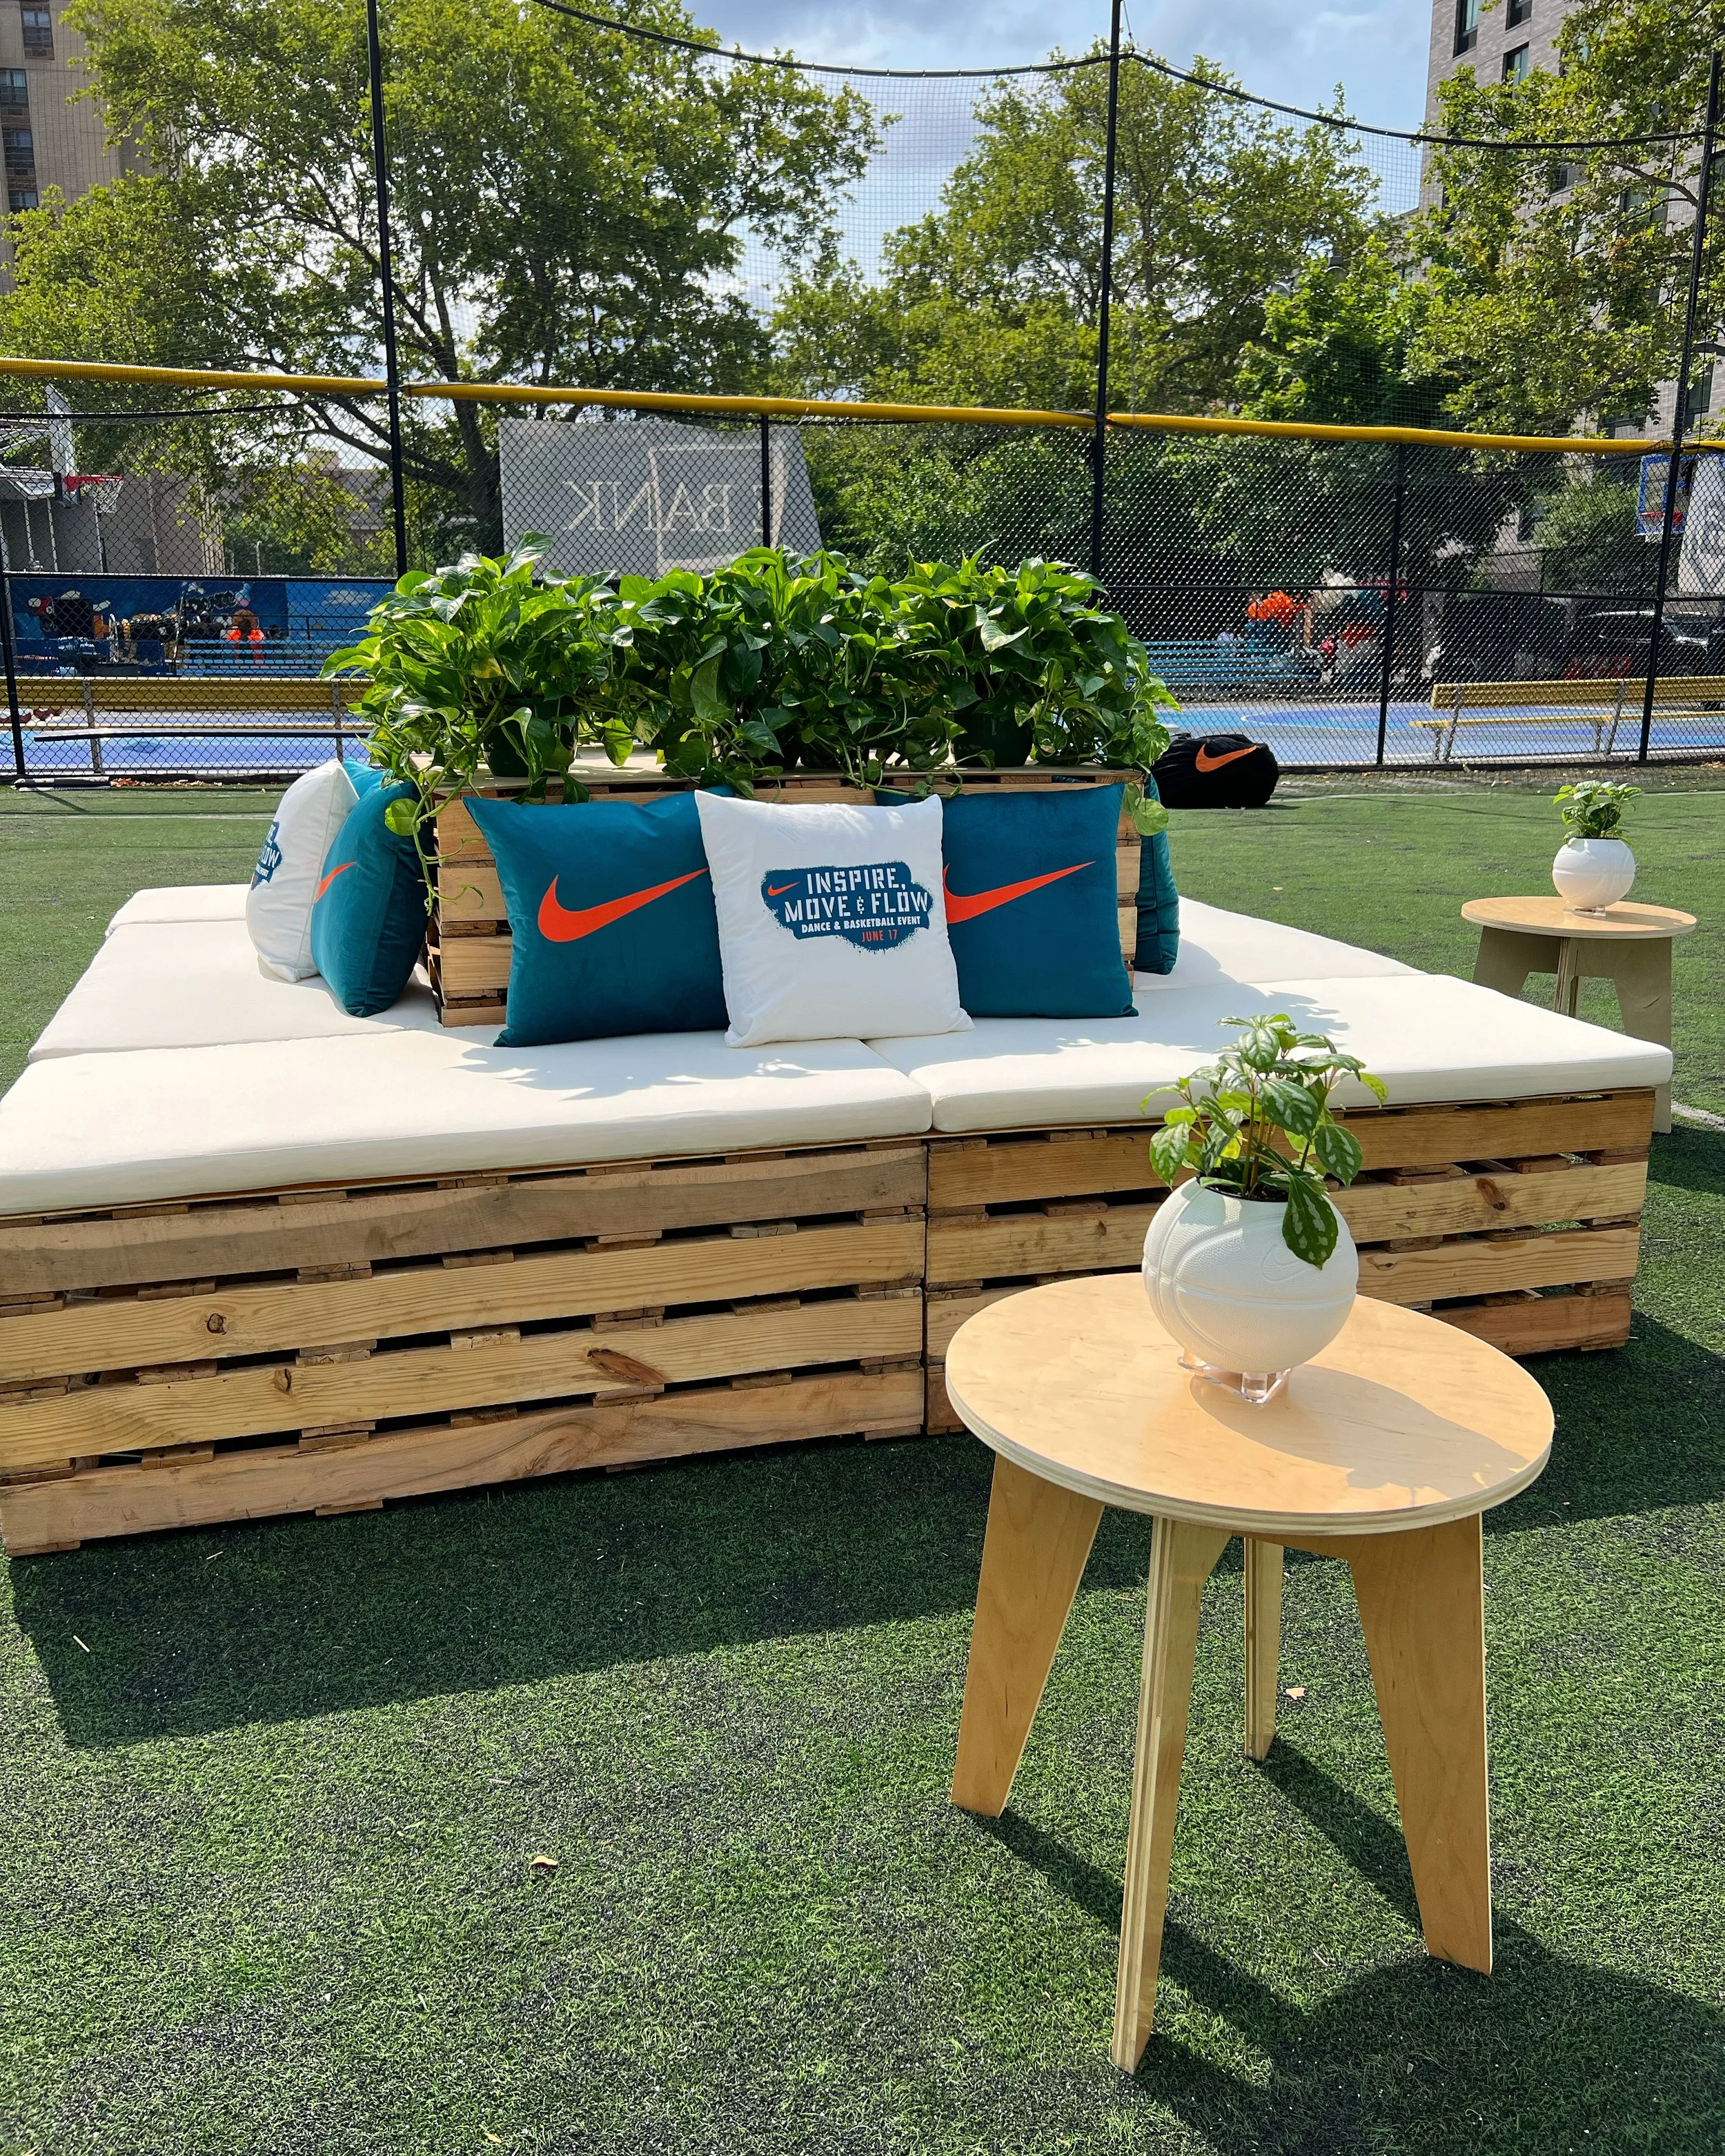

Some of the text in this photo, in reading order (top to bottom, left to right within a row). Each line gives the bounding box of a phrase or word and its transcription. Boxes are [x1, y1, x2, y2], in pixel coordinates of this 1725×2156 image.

[807, 868, 906, 894] INSPIRE,
[785, 896, 851, 922] MOVE
[871, 891, 928, 914] FLOW
[801, 916, 921, 933] DANCE & BASKETBALL EVENT
[862, 929, 898, 942] JUNE 17
